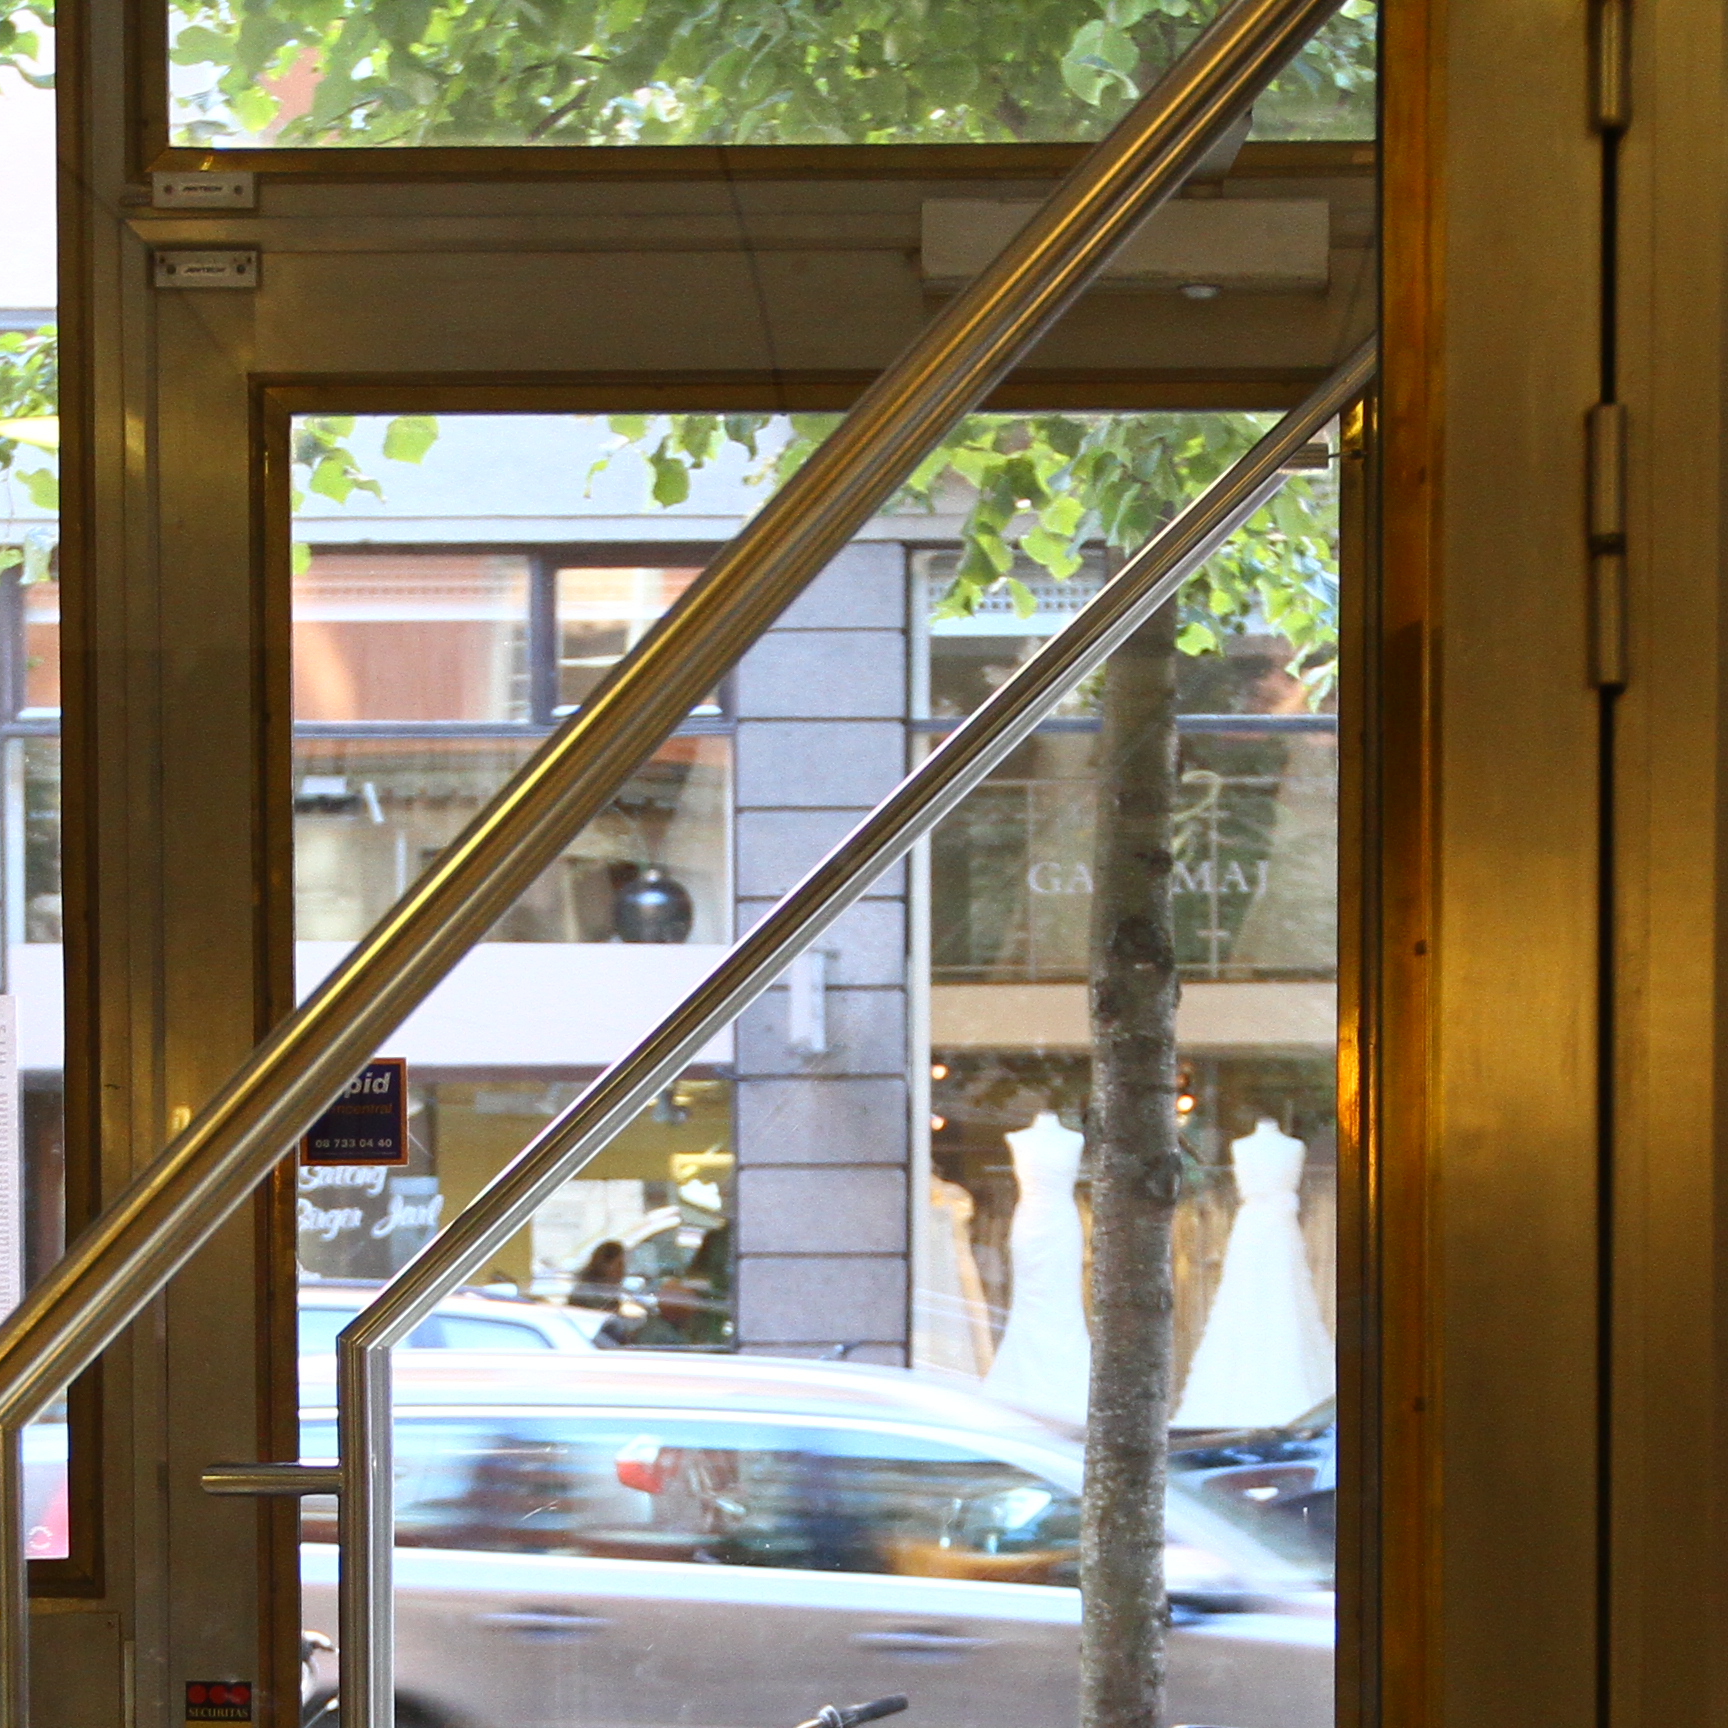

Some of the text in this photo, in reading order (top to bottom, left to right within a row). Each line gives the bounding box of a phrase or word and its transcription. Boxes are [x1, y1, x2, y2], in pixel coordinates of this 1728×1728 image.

[1027, 860, 1269, 894] GAMAJ
[343, 1072, 391, 1098] pid
[315, 1138, 393, 1149] 08 733 04 40
[188, 1707, 249, 1718] SECURITAS
